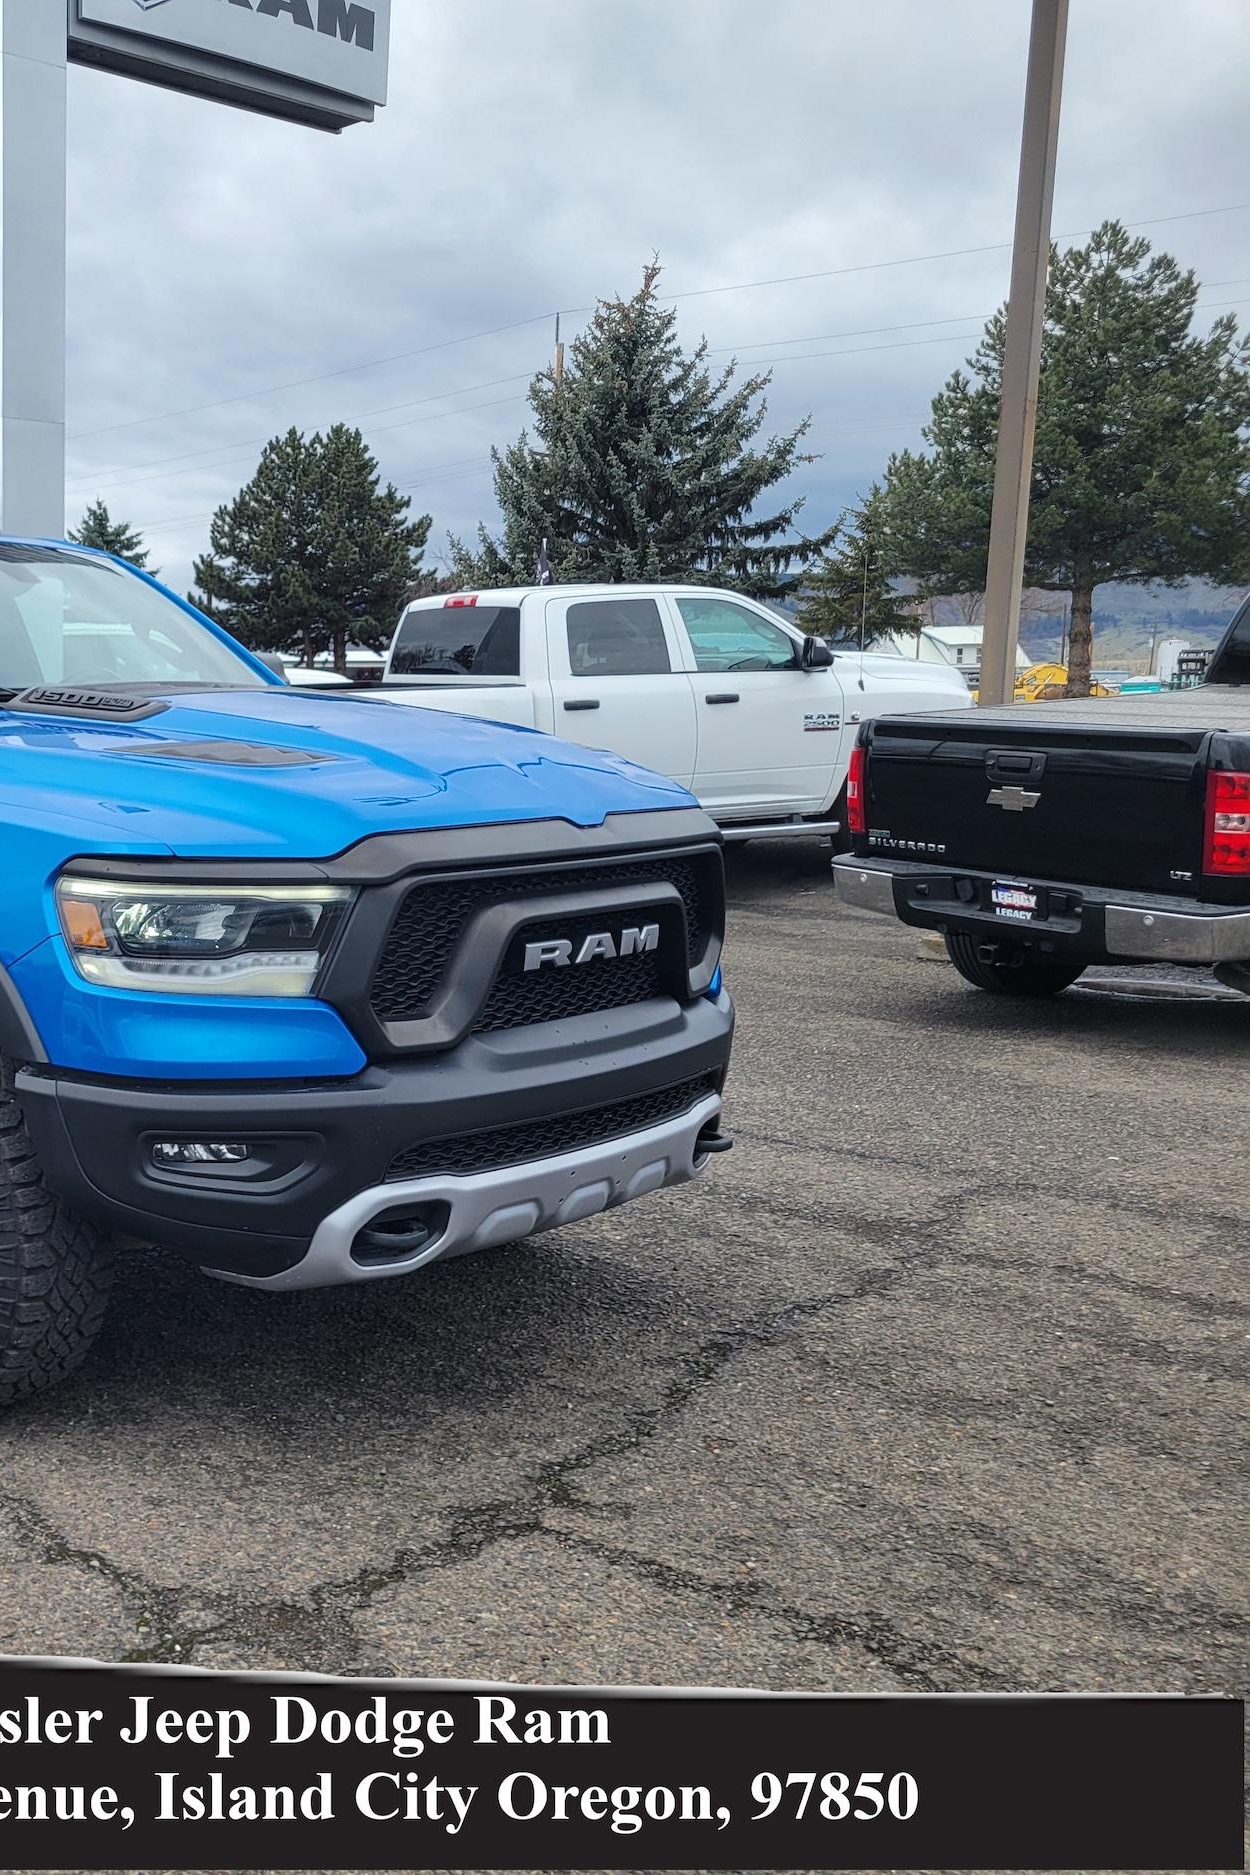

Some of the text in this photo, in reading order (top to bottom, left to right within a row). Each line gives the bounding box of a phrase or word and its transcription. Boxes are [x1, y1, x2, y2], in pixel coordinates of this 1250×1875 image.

[32, 688, 100, 706] 1500
[868, 836, 946, 853] SILVERADO
[1169, 870, 1192, 881] LTZ
[991, 889, 1038, 908] LEGACY
[995, 907, 1032, 920] LEGACY
[523, 923, 660, 972] RAM
